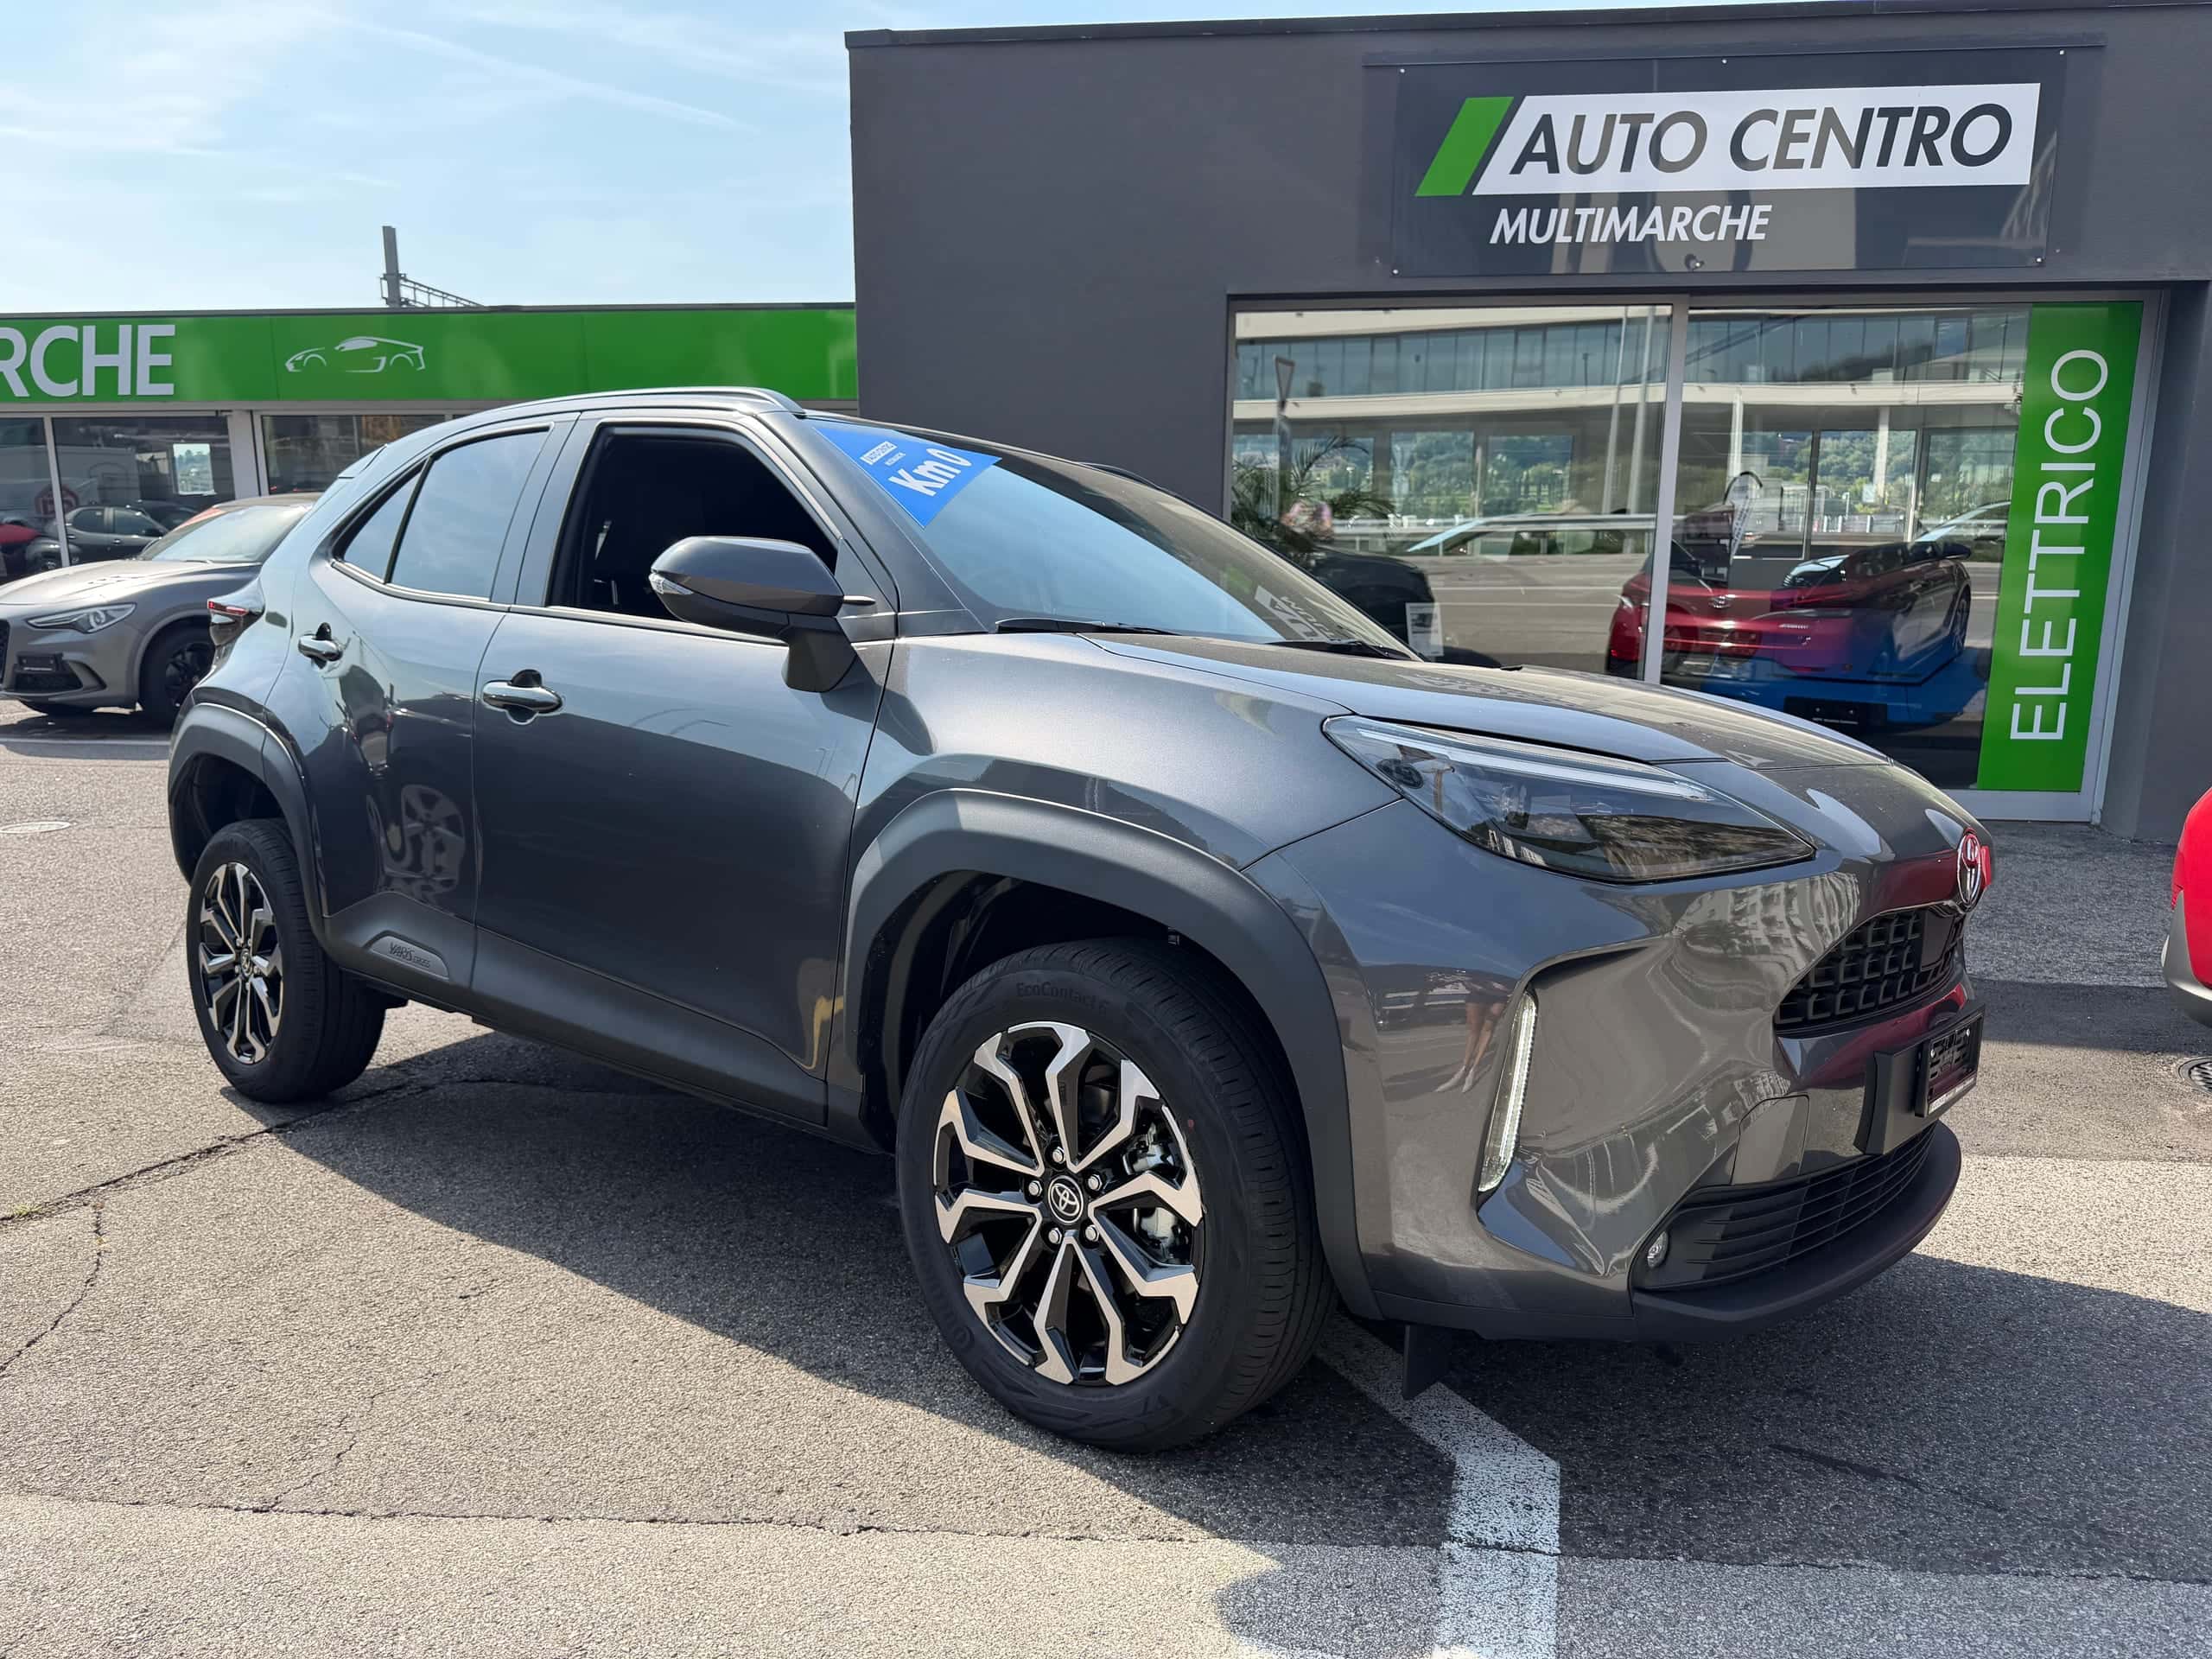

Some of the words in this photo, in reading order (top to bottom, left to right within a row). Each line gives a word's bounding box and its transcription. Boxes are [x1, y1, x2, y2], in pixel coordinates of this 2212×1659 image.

[1509, 108, 1708, 175] AUTO
[1730, 103, 2013, 172] CENTRO
[1490, 205, 1772, 245] MULTIMARCHE
[0, 325, 175, 397] RCHE
[888, 460, 962, 497] Km
[926, 448, 972, 467] 0
[2010, 349, 2108, 741] ELETTRICO
